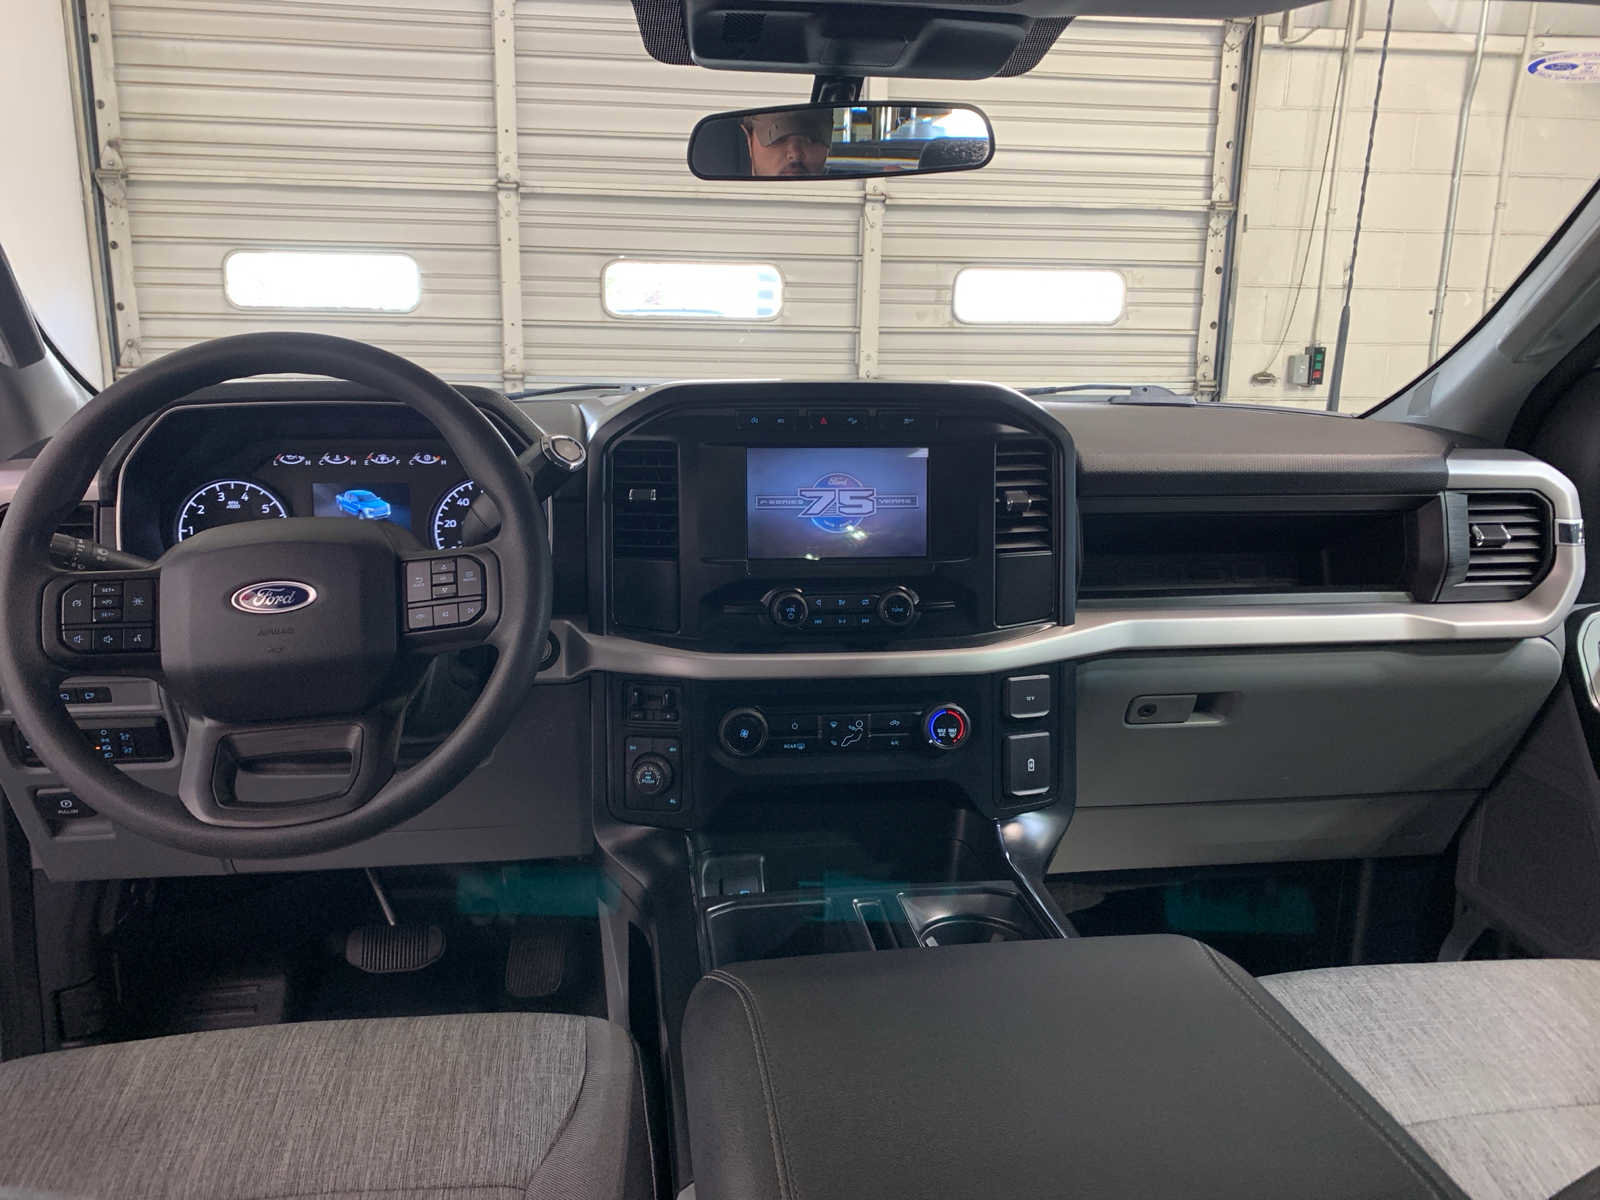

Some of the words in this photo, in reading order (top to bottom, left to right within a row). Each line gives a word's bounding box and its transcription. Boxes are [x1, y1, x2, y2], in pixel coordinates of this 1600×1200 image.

[217, 492, 226, 502] 3
[240, 492, 249, 502] 4
[456, 498, 470, 506] 40
[798, 488, 876, 517] 75
[197, 505, 205, 515] 2
[261, 504, 270, 514] 5
[443, 519, 457, 528] 20
[187, 526, 194, 536] 1
[252, 588, 296, 606] Ford
